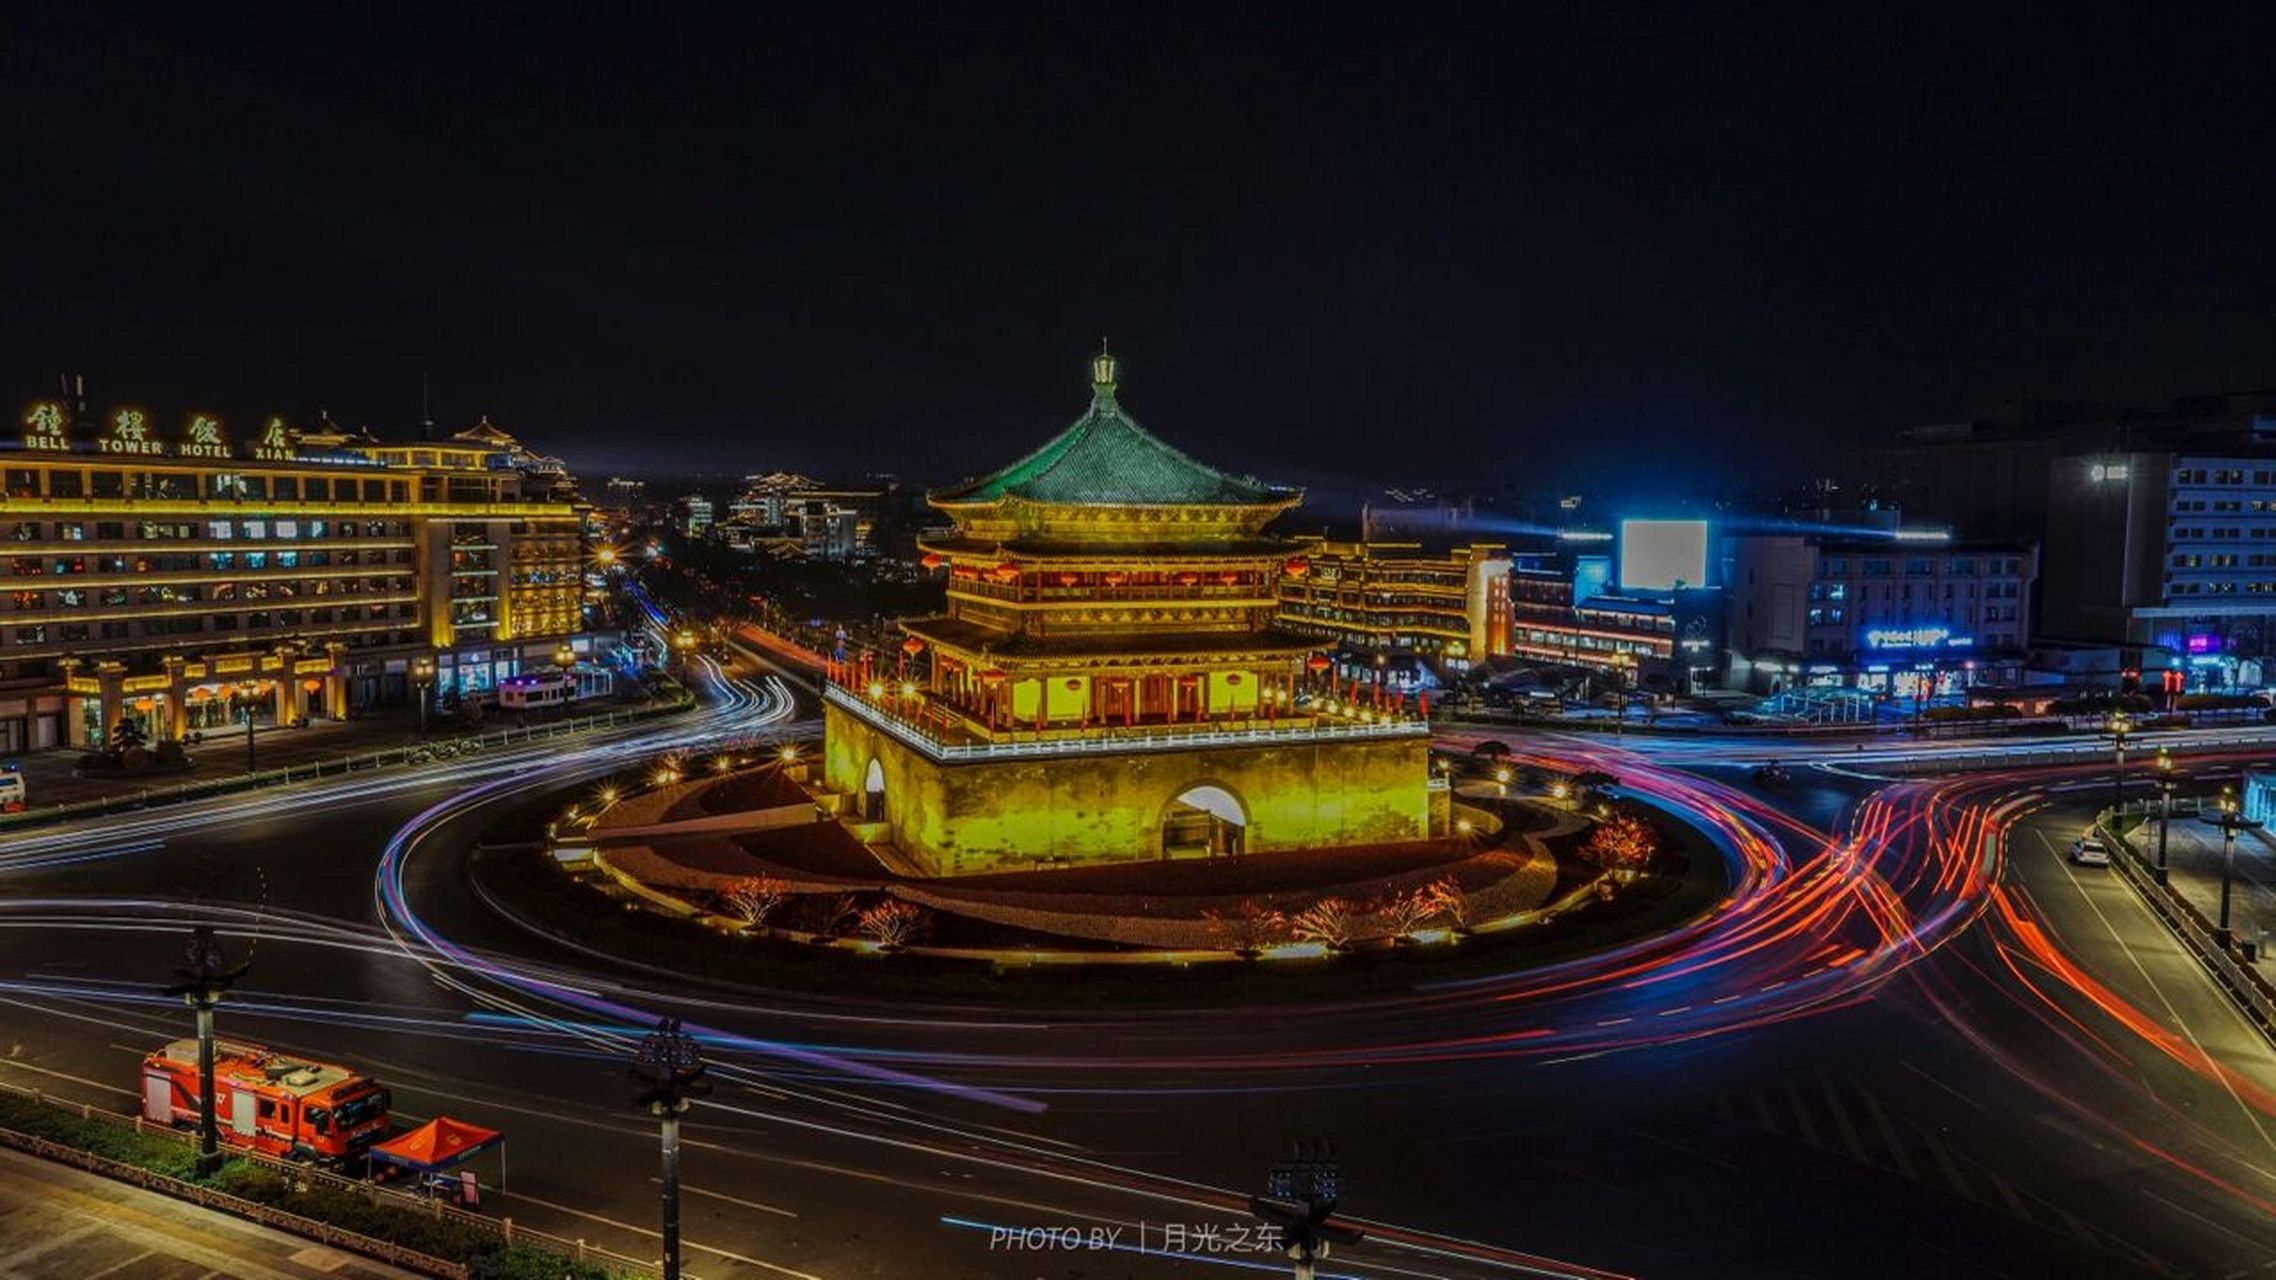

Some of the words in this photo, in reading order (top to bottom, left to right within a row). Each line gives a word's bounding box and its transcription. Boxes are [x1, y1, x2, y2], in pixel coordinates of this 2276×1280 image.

[27, 435, 70, 450] BELL
[100, 438, 162, 454] TOWER
[181, 443, 232, 459] HOTEL
[255, 448, 294, 461] XIAN
